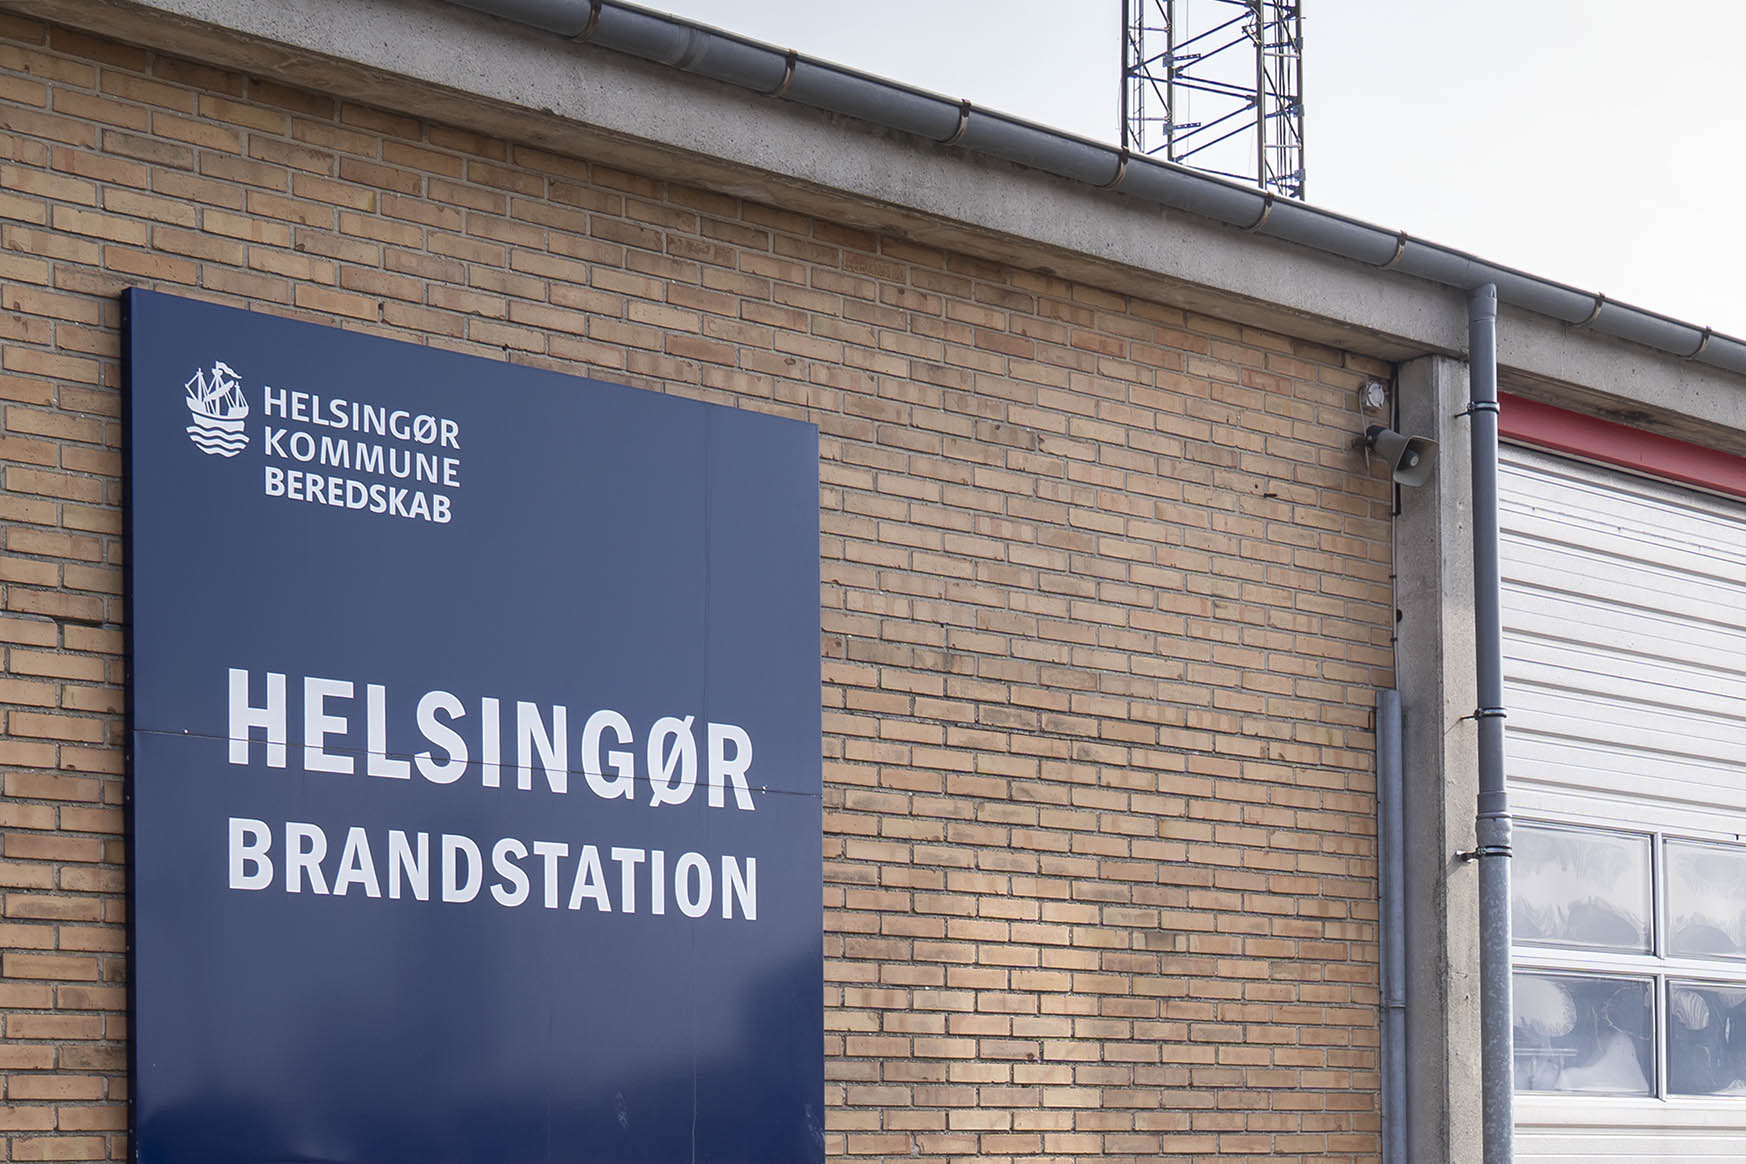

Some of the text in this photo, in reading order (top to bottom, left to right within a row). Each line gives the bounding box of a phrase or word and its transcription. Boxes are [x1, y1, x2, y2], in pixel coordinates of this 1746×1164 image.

[263, 385, 461, 450] HELSINGØR
[264, 425, 461, 488] KOMMUNE
[264, 465, 453, 524] BEREDSKAB
[228, 667, 757, 812] HELSINGØR
[228, 817, 758, 922] BRANDSTATION
